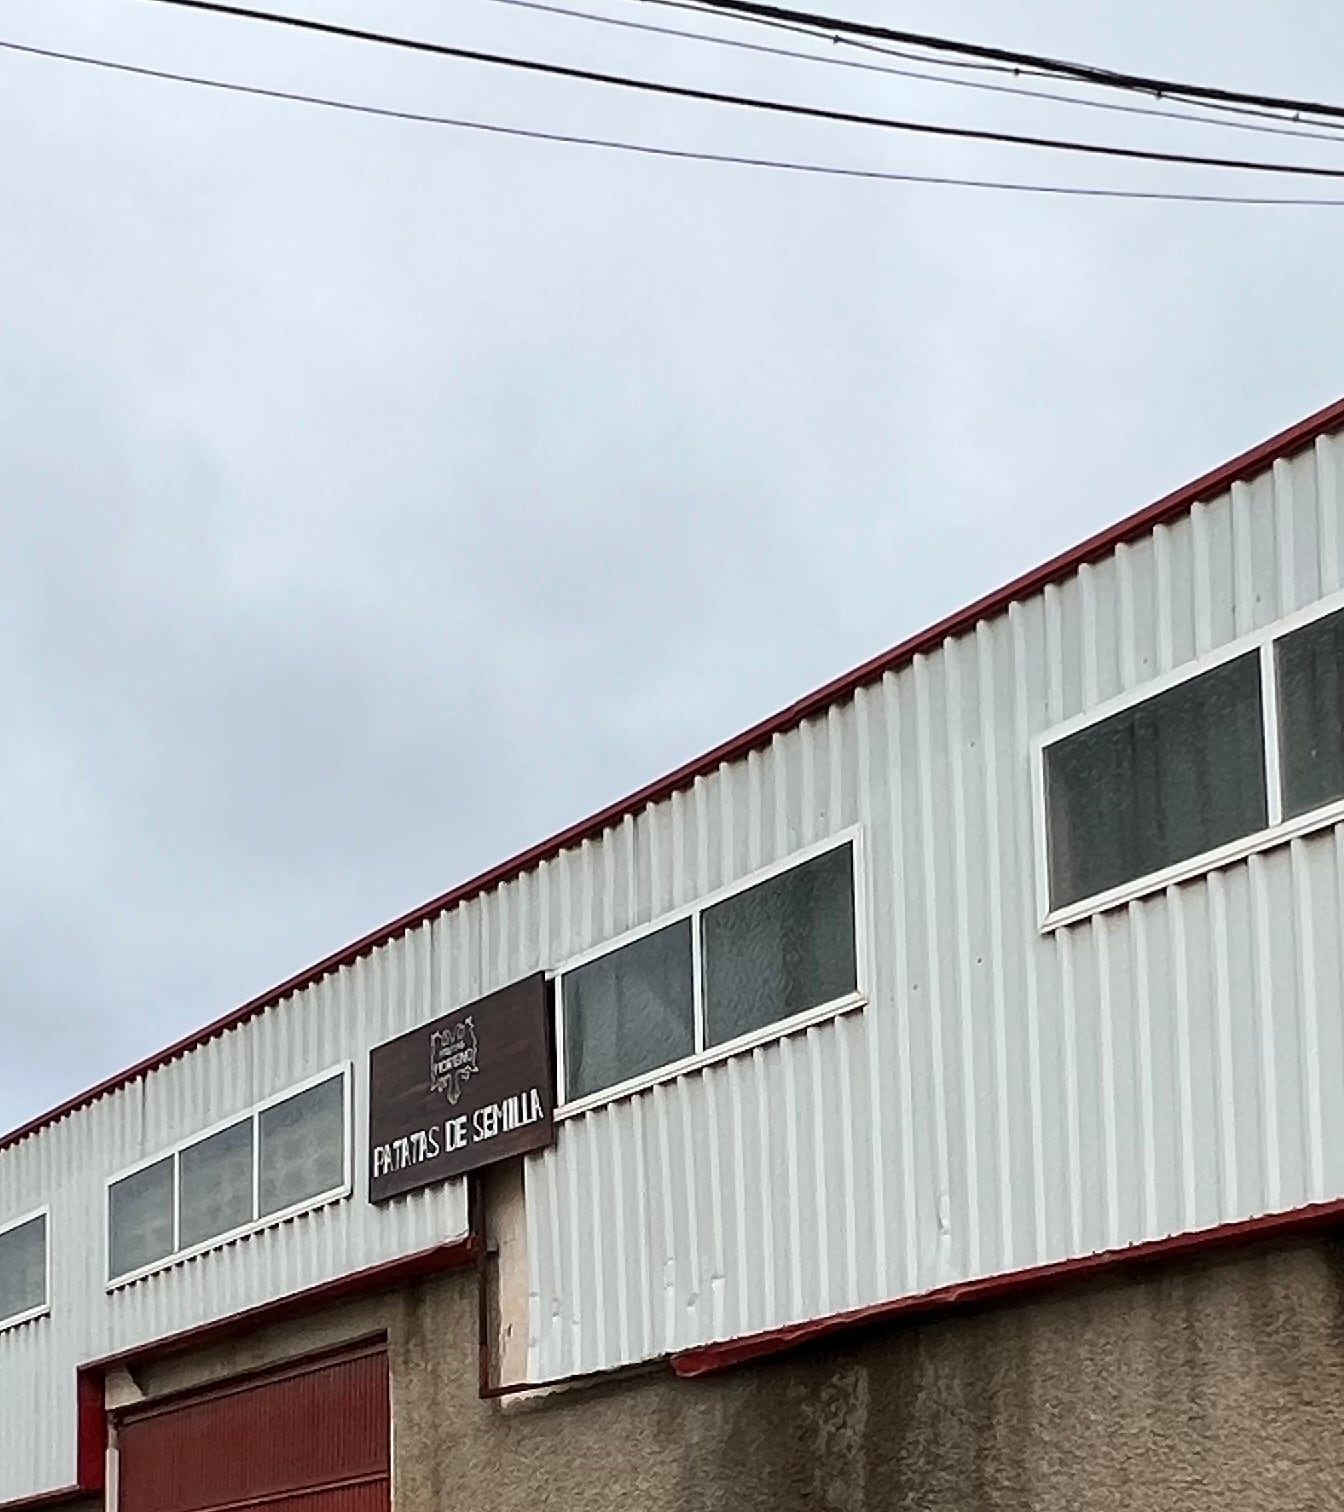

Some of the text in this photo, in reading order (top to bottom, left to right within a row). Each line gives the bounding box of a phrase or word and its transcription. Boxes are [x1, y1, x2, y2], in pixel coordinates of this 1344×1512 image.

[373, 1088, 545, 1178] PATATAS DE SEMILLA
